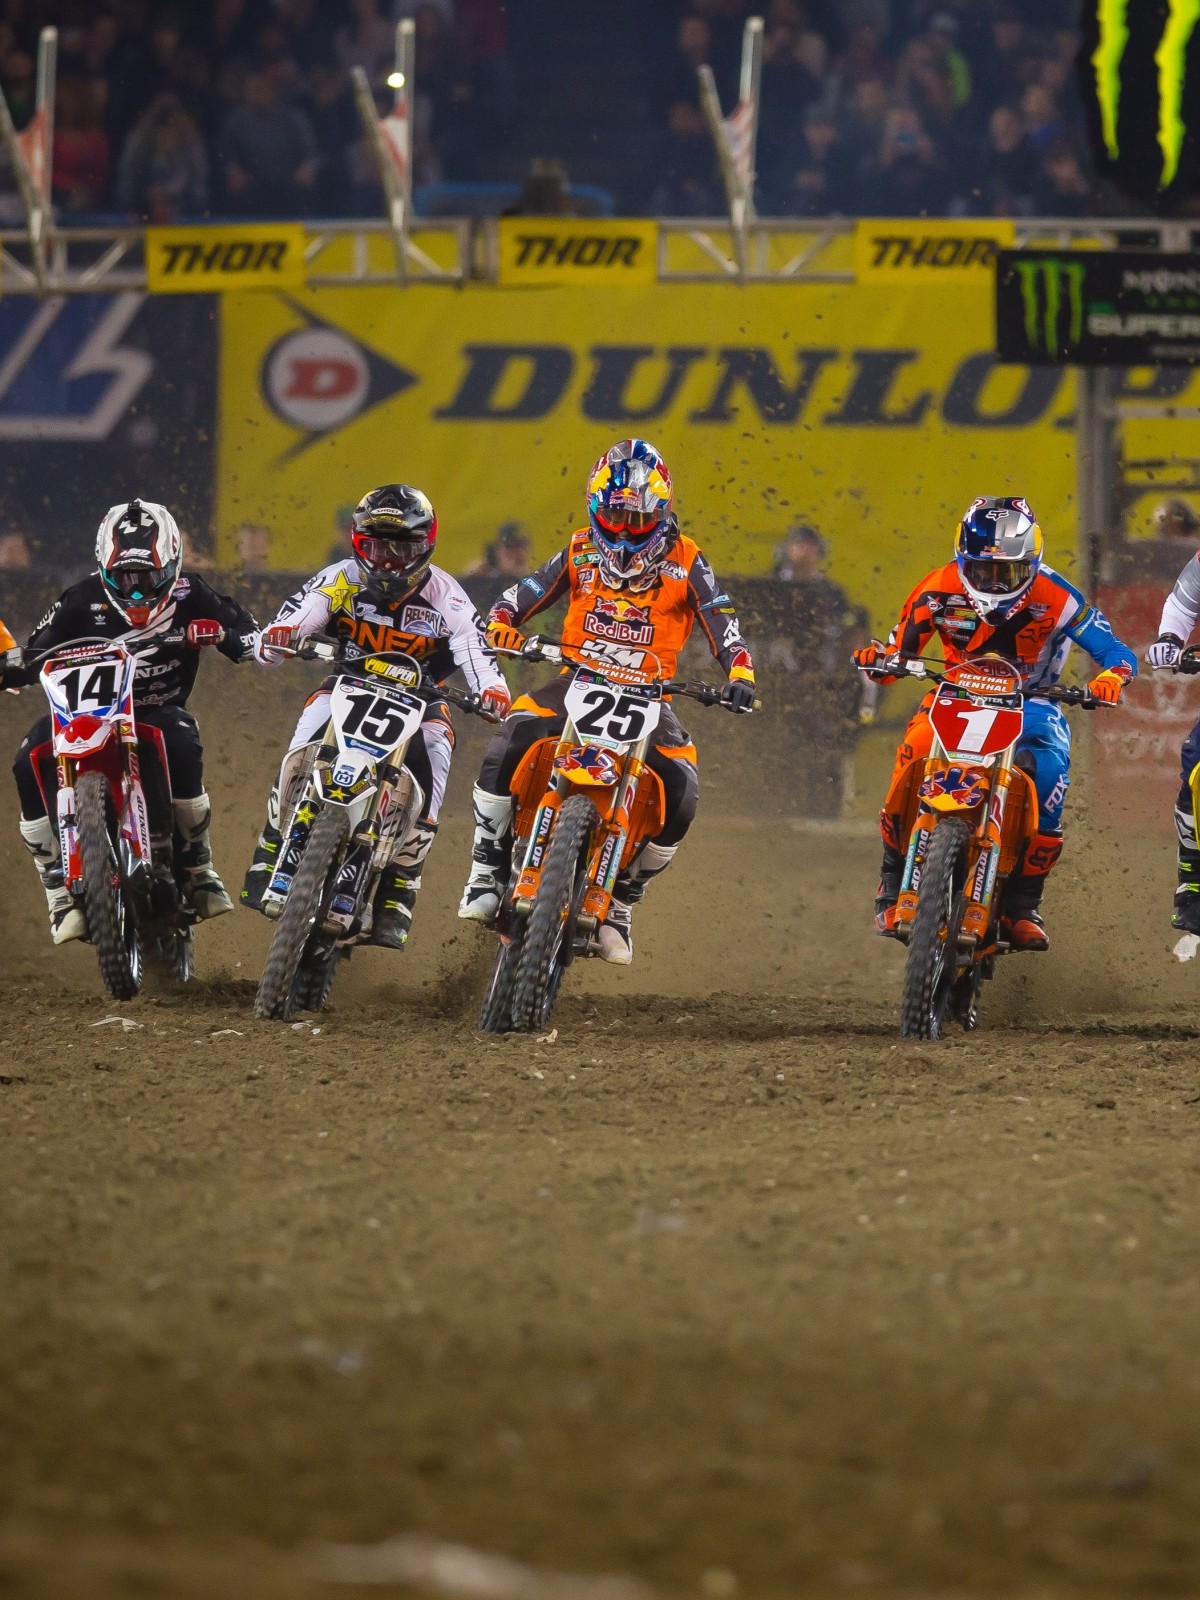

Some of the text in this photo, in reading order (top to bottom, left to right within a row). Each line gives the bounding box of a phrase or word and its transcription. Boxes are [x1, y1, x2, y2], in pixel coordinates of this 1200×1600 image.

[159, 239, 290, 275] THOR
[512, 235, 642, 269] THOR
[869, 236, 1000, 270] THOR
[585, 613, 653, 644] Red Bull
[134, 658, 181, 680] NDA
[579, 638, 647, 669] KTM
[599, 661, 649, 677] RENTHAL
[57, 665, 119, 712] 14
[597, 668, 647, 684] RENTHAL
[958, 680, 1008, 693] RENTHAL
[960, 673, 1009, 685] RENTHAL
[341, 693, 412, 746] 15
[576, 690, 650, 742] 25
[956, 708, 999, 753] 1
[1044, 774, 1068, 814] FOX
[531, 806, 554, 868] DUNOP
[595, 831, 617, 887] DUNLOP
[972, 849, 989, 902] DUNLOP
